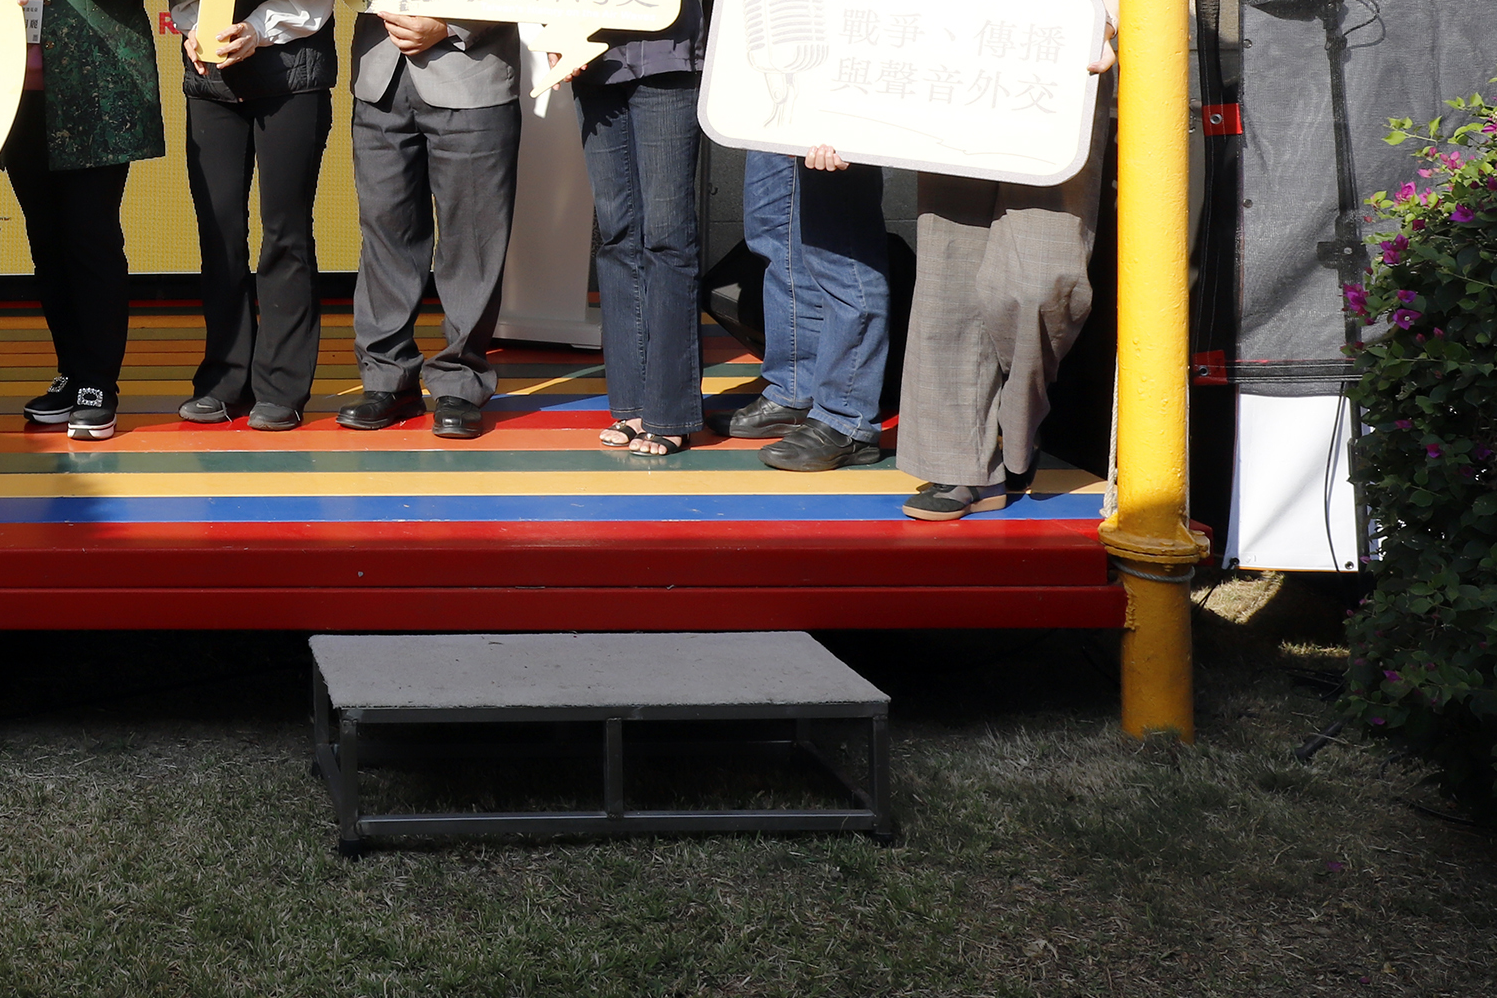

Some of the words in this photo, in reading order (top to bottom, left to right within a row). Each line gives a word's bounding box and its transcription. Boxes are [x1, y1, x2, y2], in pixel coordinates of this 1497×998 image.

[838, 7, 1066, 65] 戰爭、傳播
[830, 56, 1059, 114] 與聲音外交
